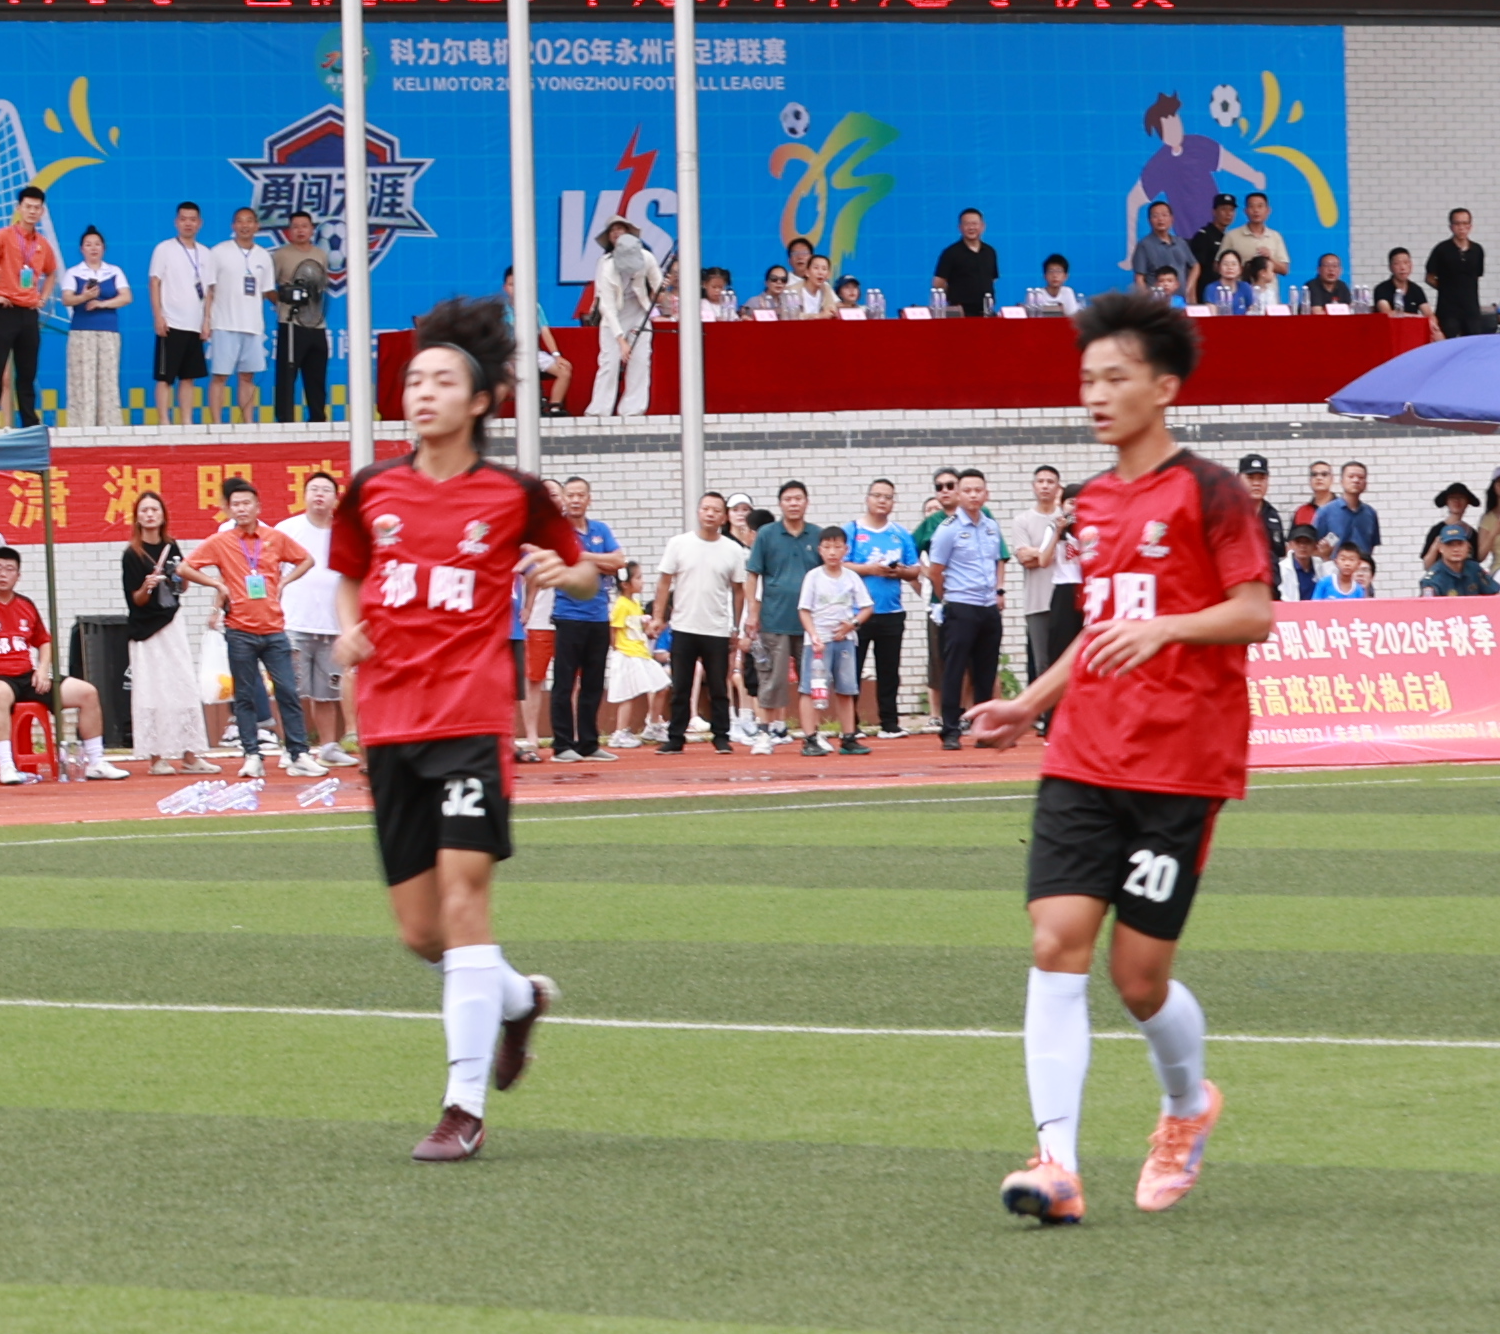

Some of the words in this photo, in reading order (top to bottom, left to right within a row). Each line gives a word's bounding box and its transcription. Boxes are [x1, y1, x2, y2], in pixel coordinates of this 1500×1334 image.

[393, 76, 430, 91] KELI
[432, 76, 494, 91] MOTOR
[537, 76, 631, 91] YONGZHOU
[633, 76, 718, 91] FOOTLL
[720, 76, 786, 91] LEAGUE
[379, 559, 476, 613] 祁阳
[441, 777, 486, 818] 32
[1122, 848, 1179, 903] 20
